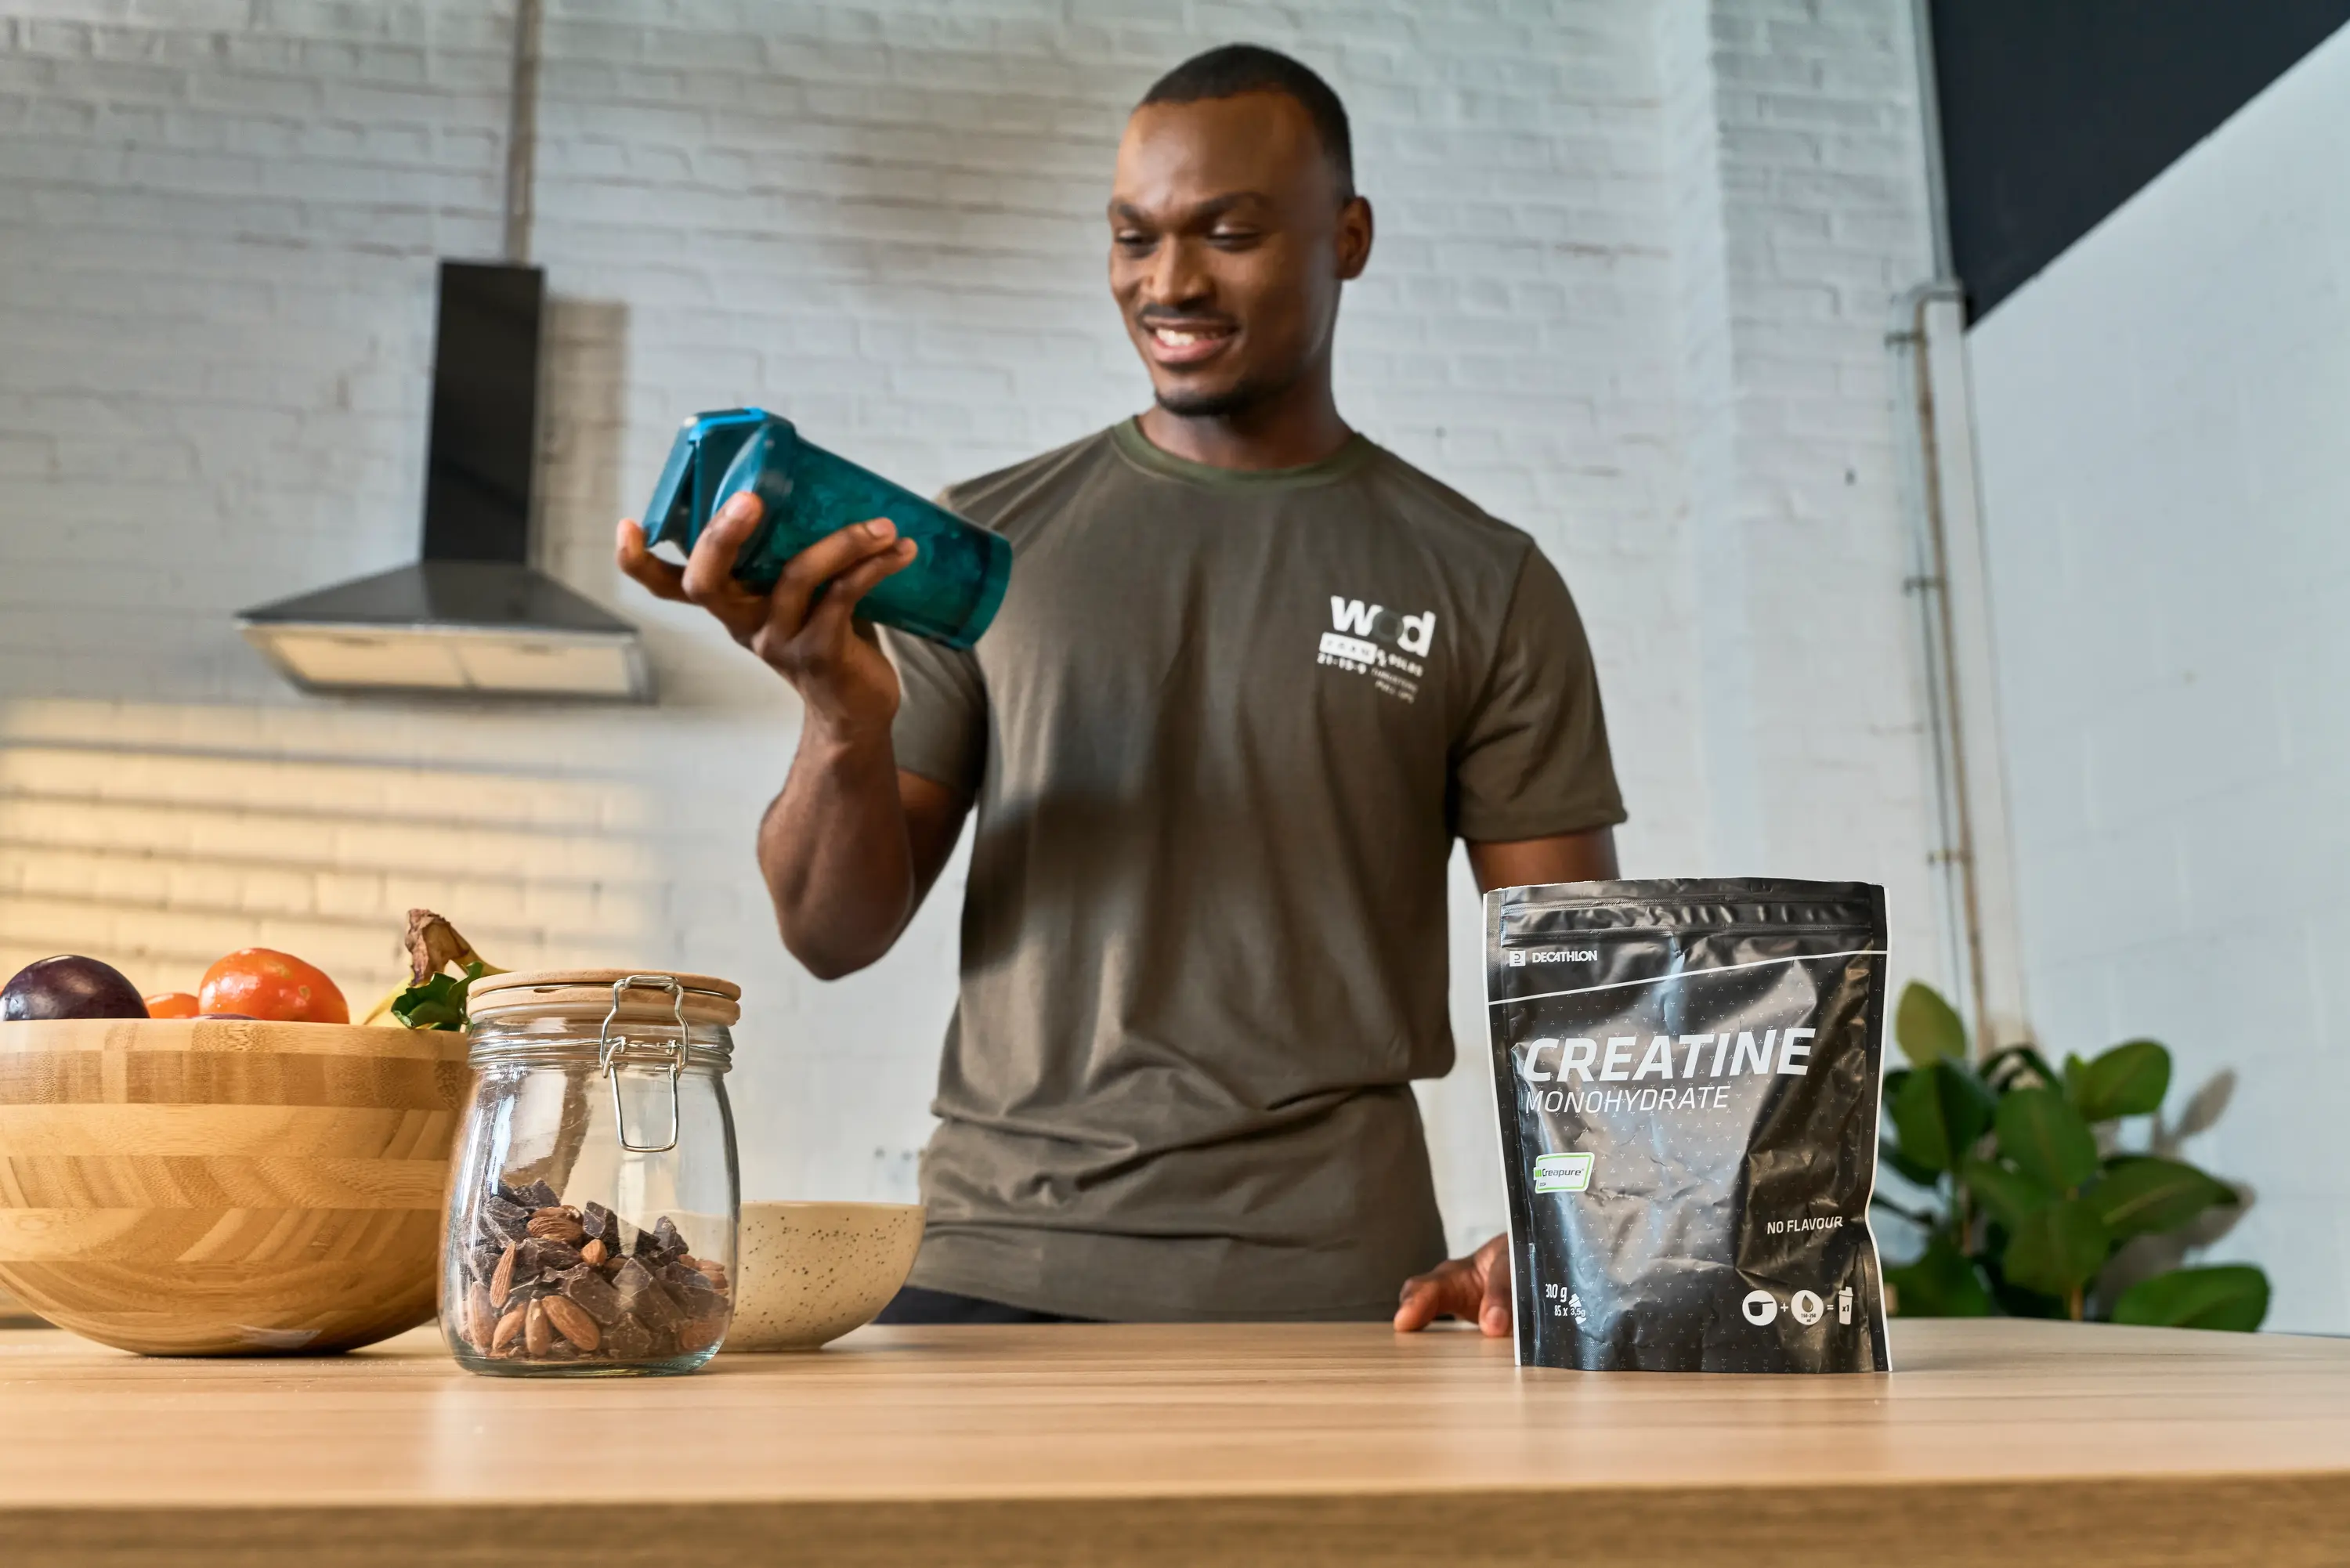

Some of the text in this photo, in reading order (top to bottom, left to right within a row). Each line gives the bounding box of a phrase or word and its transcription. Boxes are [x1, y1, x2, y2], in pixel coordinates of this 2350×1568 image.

[1330, 595, 1437, 658] wod
[1532, 950, 1598, 963] DECATHLON
[1524, 1028, 1817, 1082] CREATINE
[1525, 1086, 1732, 1114] MONOHYDRATE
[1542, 1168, 1582, 1178] Creapure
[1766, 1216, 1843, 1234] NO FLAVOUR
[1560, 1287, 1567, 1302] g
[1554, 1305, 1561, 1317] 85
